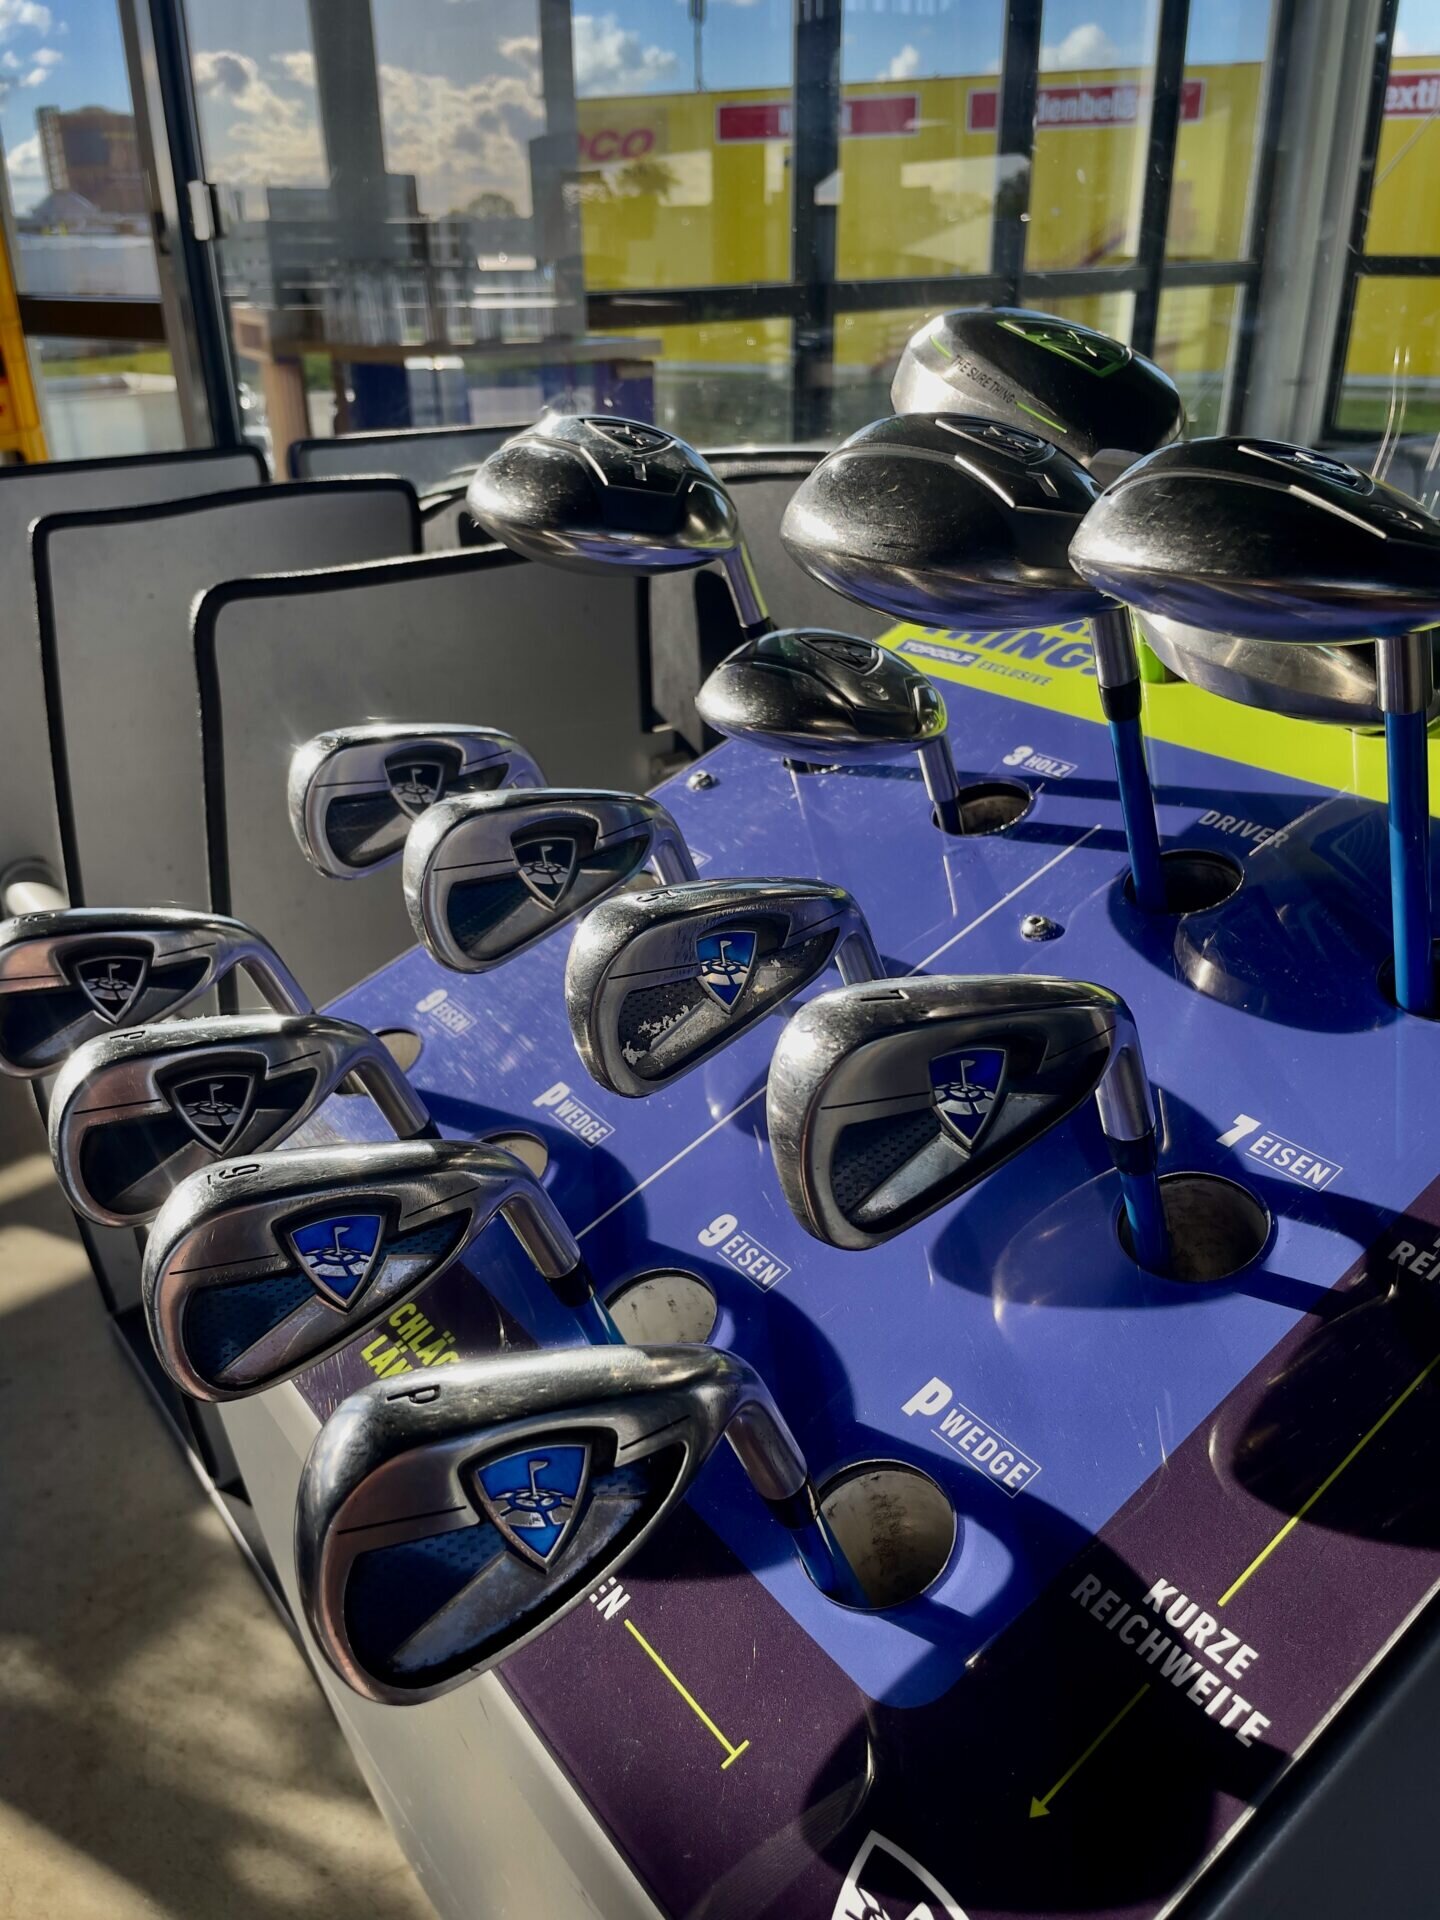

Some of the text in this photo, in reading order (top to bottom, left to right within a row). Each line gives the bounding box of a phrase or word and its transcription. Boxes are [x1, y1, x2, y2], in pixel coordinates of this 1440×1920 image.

[966, 367, 993, 388] SURE
[988, 380, 1016, 404] THING
[902, 641, 1053, 686] TOPGOLF EXCLUSIVE
[1002, 745, 1071, 777] 3 HOLZ
[1198, 810, 1290, 849] DRIVER
[416, 989, 471, 1033] 9 EISEN
[532, 1081, 608, 1143] P WEDGE
[1215, 1113, 1331, 1185] 7 EISEN
[697, 1213, 782, 1285] 9 EISEN
[1388, 1240, 1440, 1281] REI
[386, 1384, 441, 1404] P
[900, 1376, 1031, 1489] P WEDGE
[1142, 1577, 1260, 1680] KURZE
[1070, 1573, 1272, 1749] REICHWEITE
